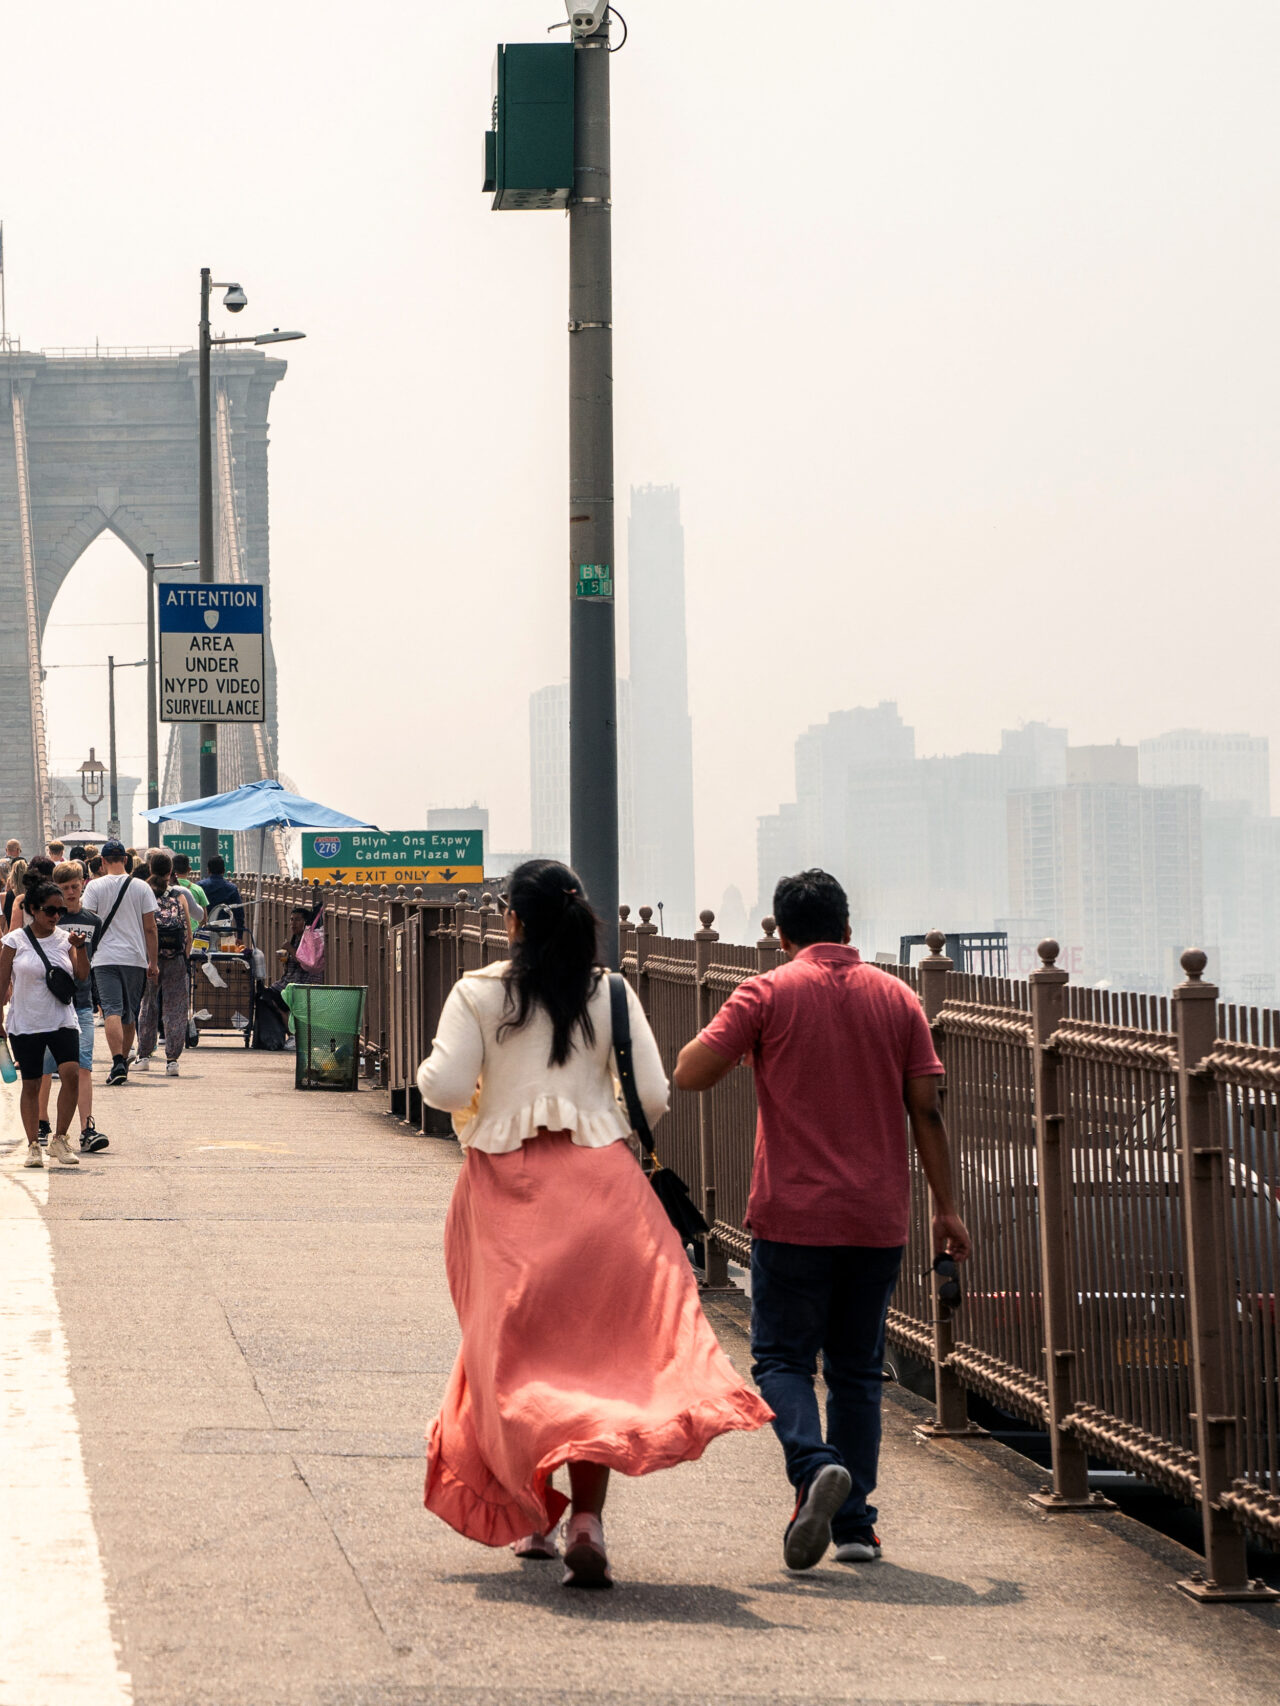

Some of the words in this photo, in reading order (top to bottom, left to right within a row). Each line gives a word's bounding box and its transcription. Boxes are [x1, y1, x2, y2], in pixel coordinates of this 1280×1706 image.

[166, 590, 257, 607] ATTENTION
[189, 636, 234, 651] AREA
[185, 657, 239, 672] UNDER
[164, 678, 208, 693] NYPD
[216, 679, 260, 694] VIDEO
[166, 699, 259, 715] SURVEILLANCE
[171, 840, 200, 850] Tillar
[218, 840, 229, 850] St
[319, 843, 336, 853] 278
[352, 836, 387, 848] Bklyn
[402, 836, 426, 846] Qns
[431, 835, 471, 847] Expwy
[355, 850, 407, 860] Cadman
[414, 850, 449, 859] Plaza
[455, 849, 466, 859] W
[355, 871, 387, 881] EXIT
[394, 870, 430, 881] ONLY
[968, 945, 1084, 974] WELCME
